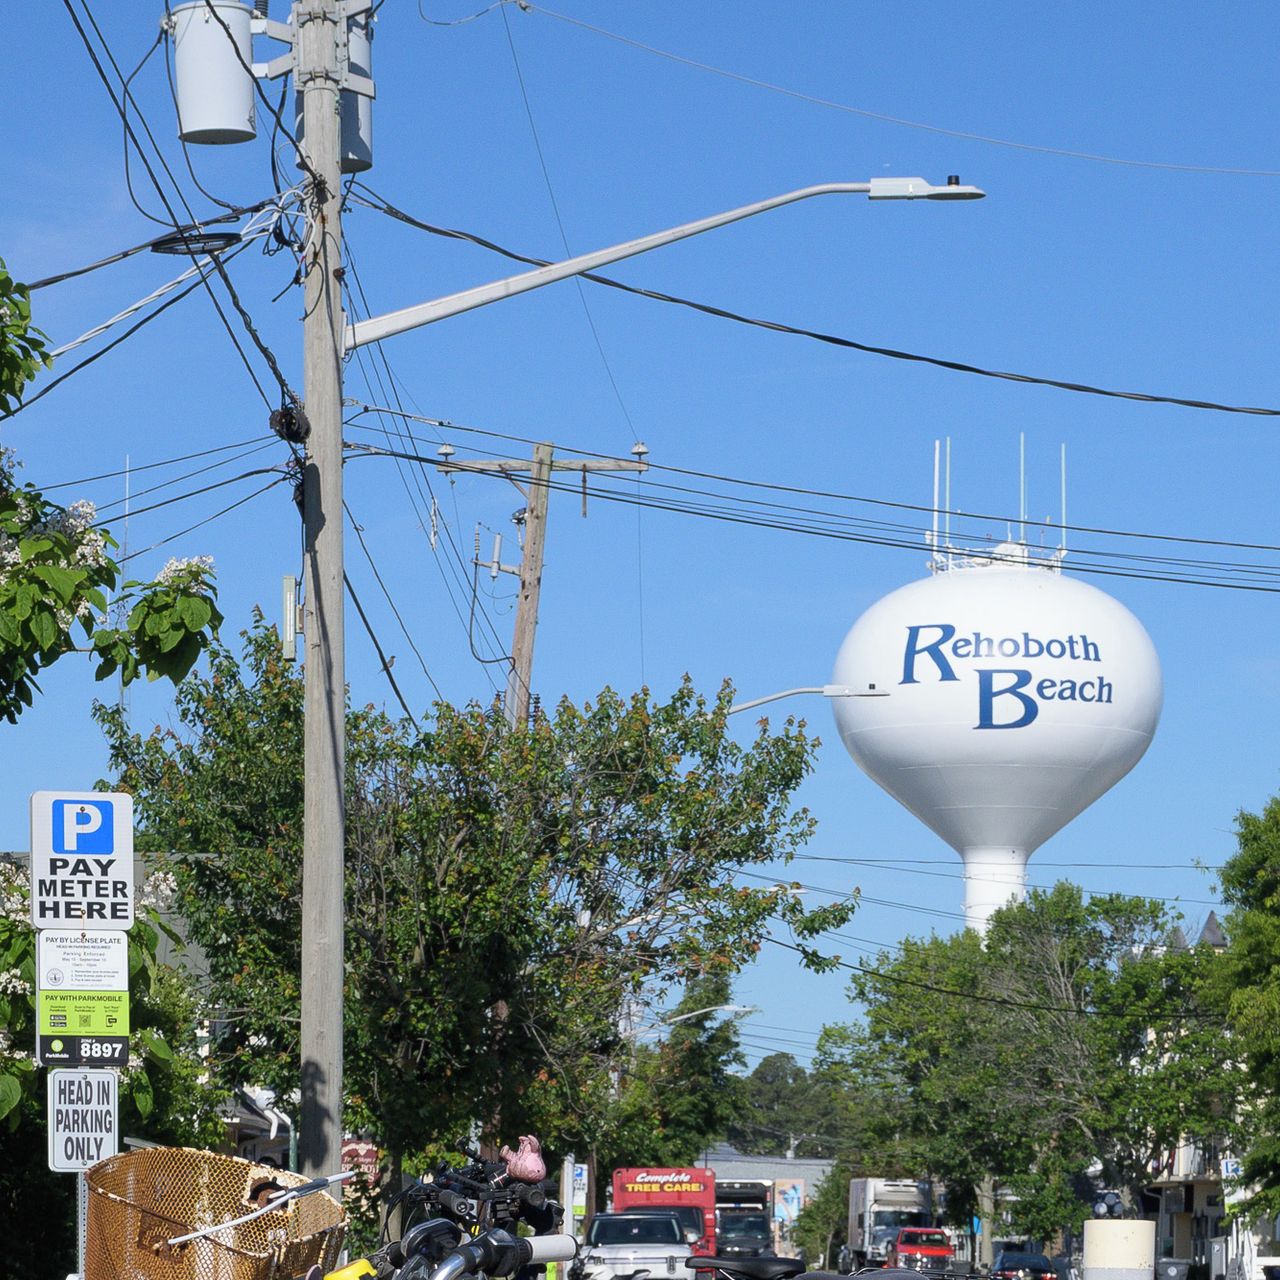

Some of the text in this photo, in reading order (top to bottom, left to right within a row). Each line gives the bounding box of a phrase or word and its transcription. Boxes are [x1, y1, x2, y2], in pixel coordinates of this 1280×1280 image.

[898, 623, 1101, 684] Rehoboth
[972, 669, 1112, 730] Beach
[63, 803, 103, 851] P
[49, 858, 117, 877] PAY
[38, 879, 129, 898] METER
[39, 900, 129, 920] HERE
[80, 1043, 123, 1058] 8897
[58, 1080, 110, 1105] HEAD IN
[56, 1109, 113, 1133] PARKING
[64, 1136, 104, 1161] ONLY
[625, 1183, 701, 1192] TREE CARE
[635, 1172, 691, 1183] Complete
